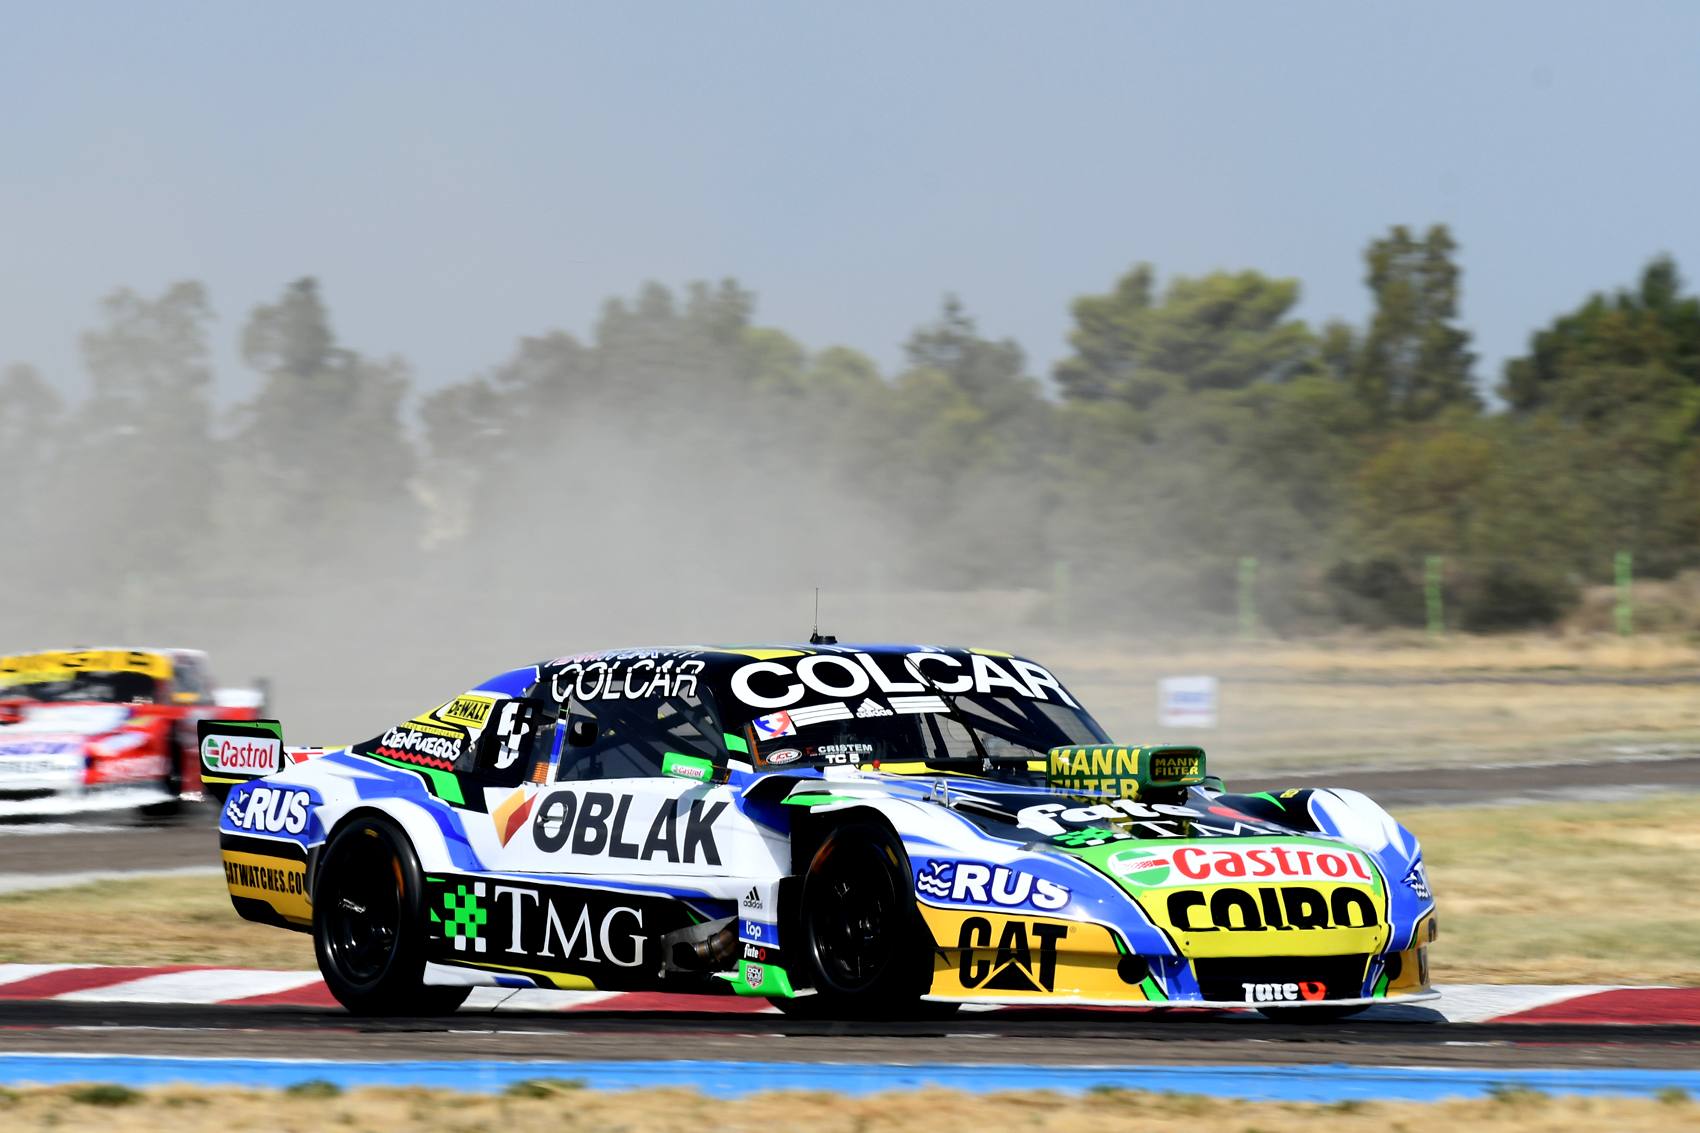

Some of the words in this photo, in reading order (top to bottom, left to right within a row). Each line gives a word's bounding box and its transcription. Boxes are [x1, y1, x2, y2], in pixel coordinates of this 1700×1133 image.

[552, 660, 705, 702] COLCAR
[731, 652, 1080, 709] COLCAR
[856, 708, 894, 718] adidas
[221, 741, 274, 769] Castrol
[1051, 749, 1141, 776] MANN
[1155, 758, 1198, 767] MANN
[1155, 766, 1198, 776] FILTER
[243, 788, 310, 834] RUS
[532, 790, 731, 866] OBLAK
[1171, 847, 1371, 880] Castrol
[743, 900, 763, 910] adidas
[952, 864, 1071, 910] RUS
[494, 885, 648, 968] TMG
[958, 916, 1069, 992] CAT
